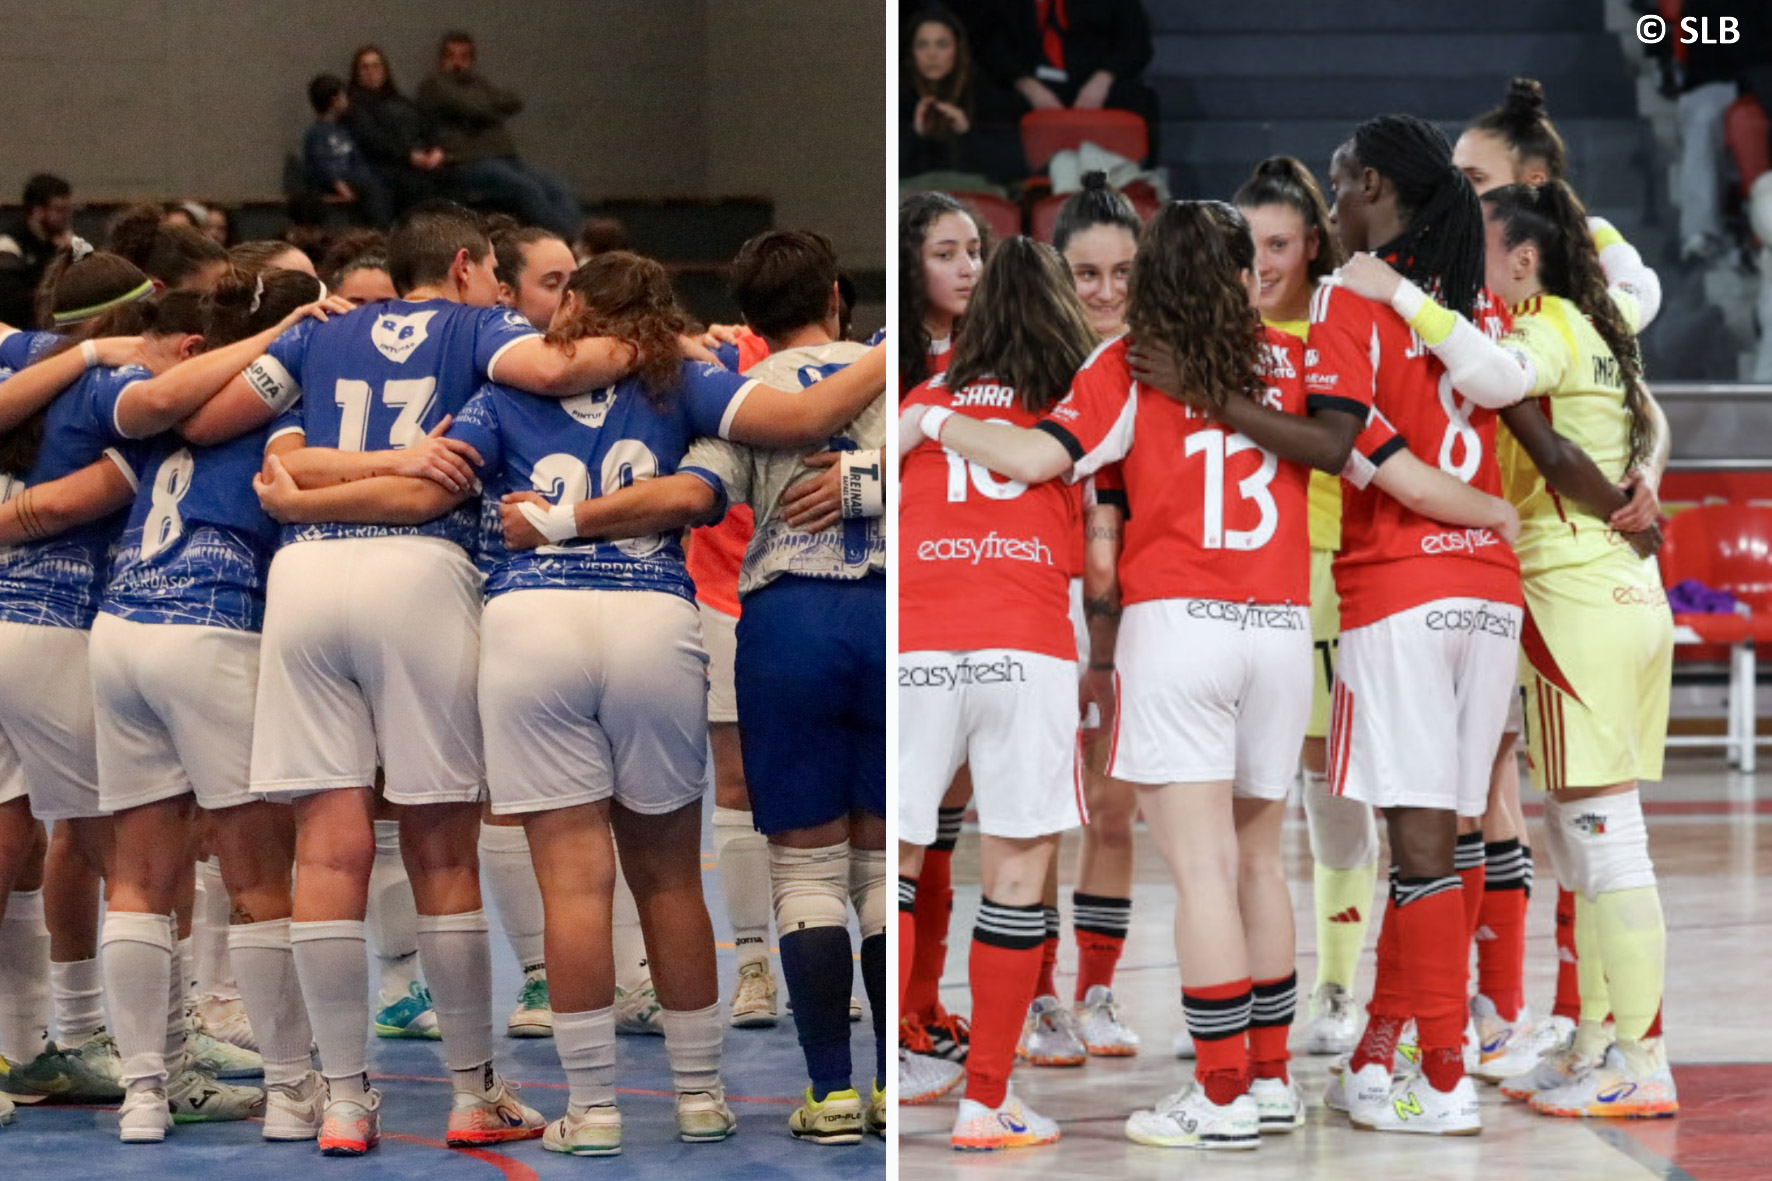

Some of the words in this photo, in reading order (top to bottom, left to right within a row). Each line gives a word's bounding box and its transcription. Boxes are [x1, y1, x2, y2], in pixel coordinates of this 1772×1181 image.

[335, 376, 439, 451] 13
[951, 384, 1015, 408] SARA
[1438, 367, 1483, 483] 8
[140, 447, 195, 561] 8
[1184, 428, 1280, 551] 13
[917, 531, 1054, 565] easyfresh
[898, 654, 1026, 691] easyfresh
